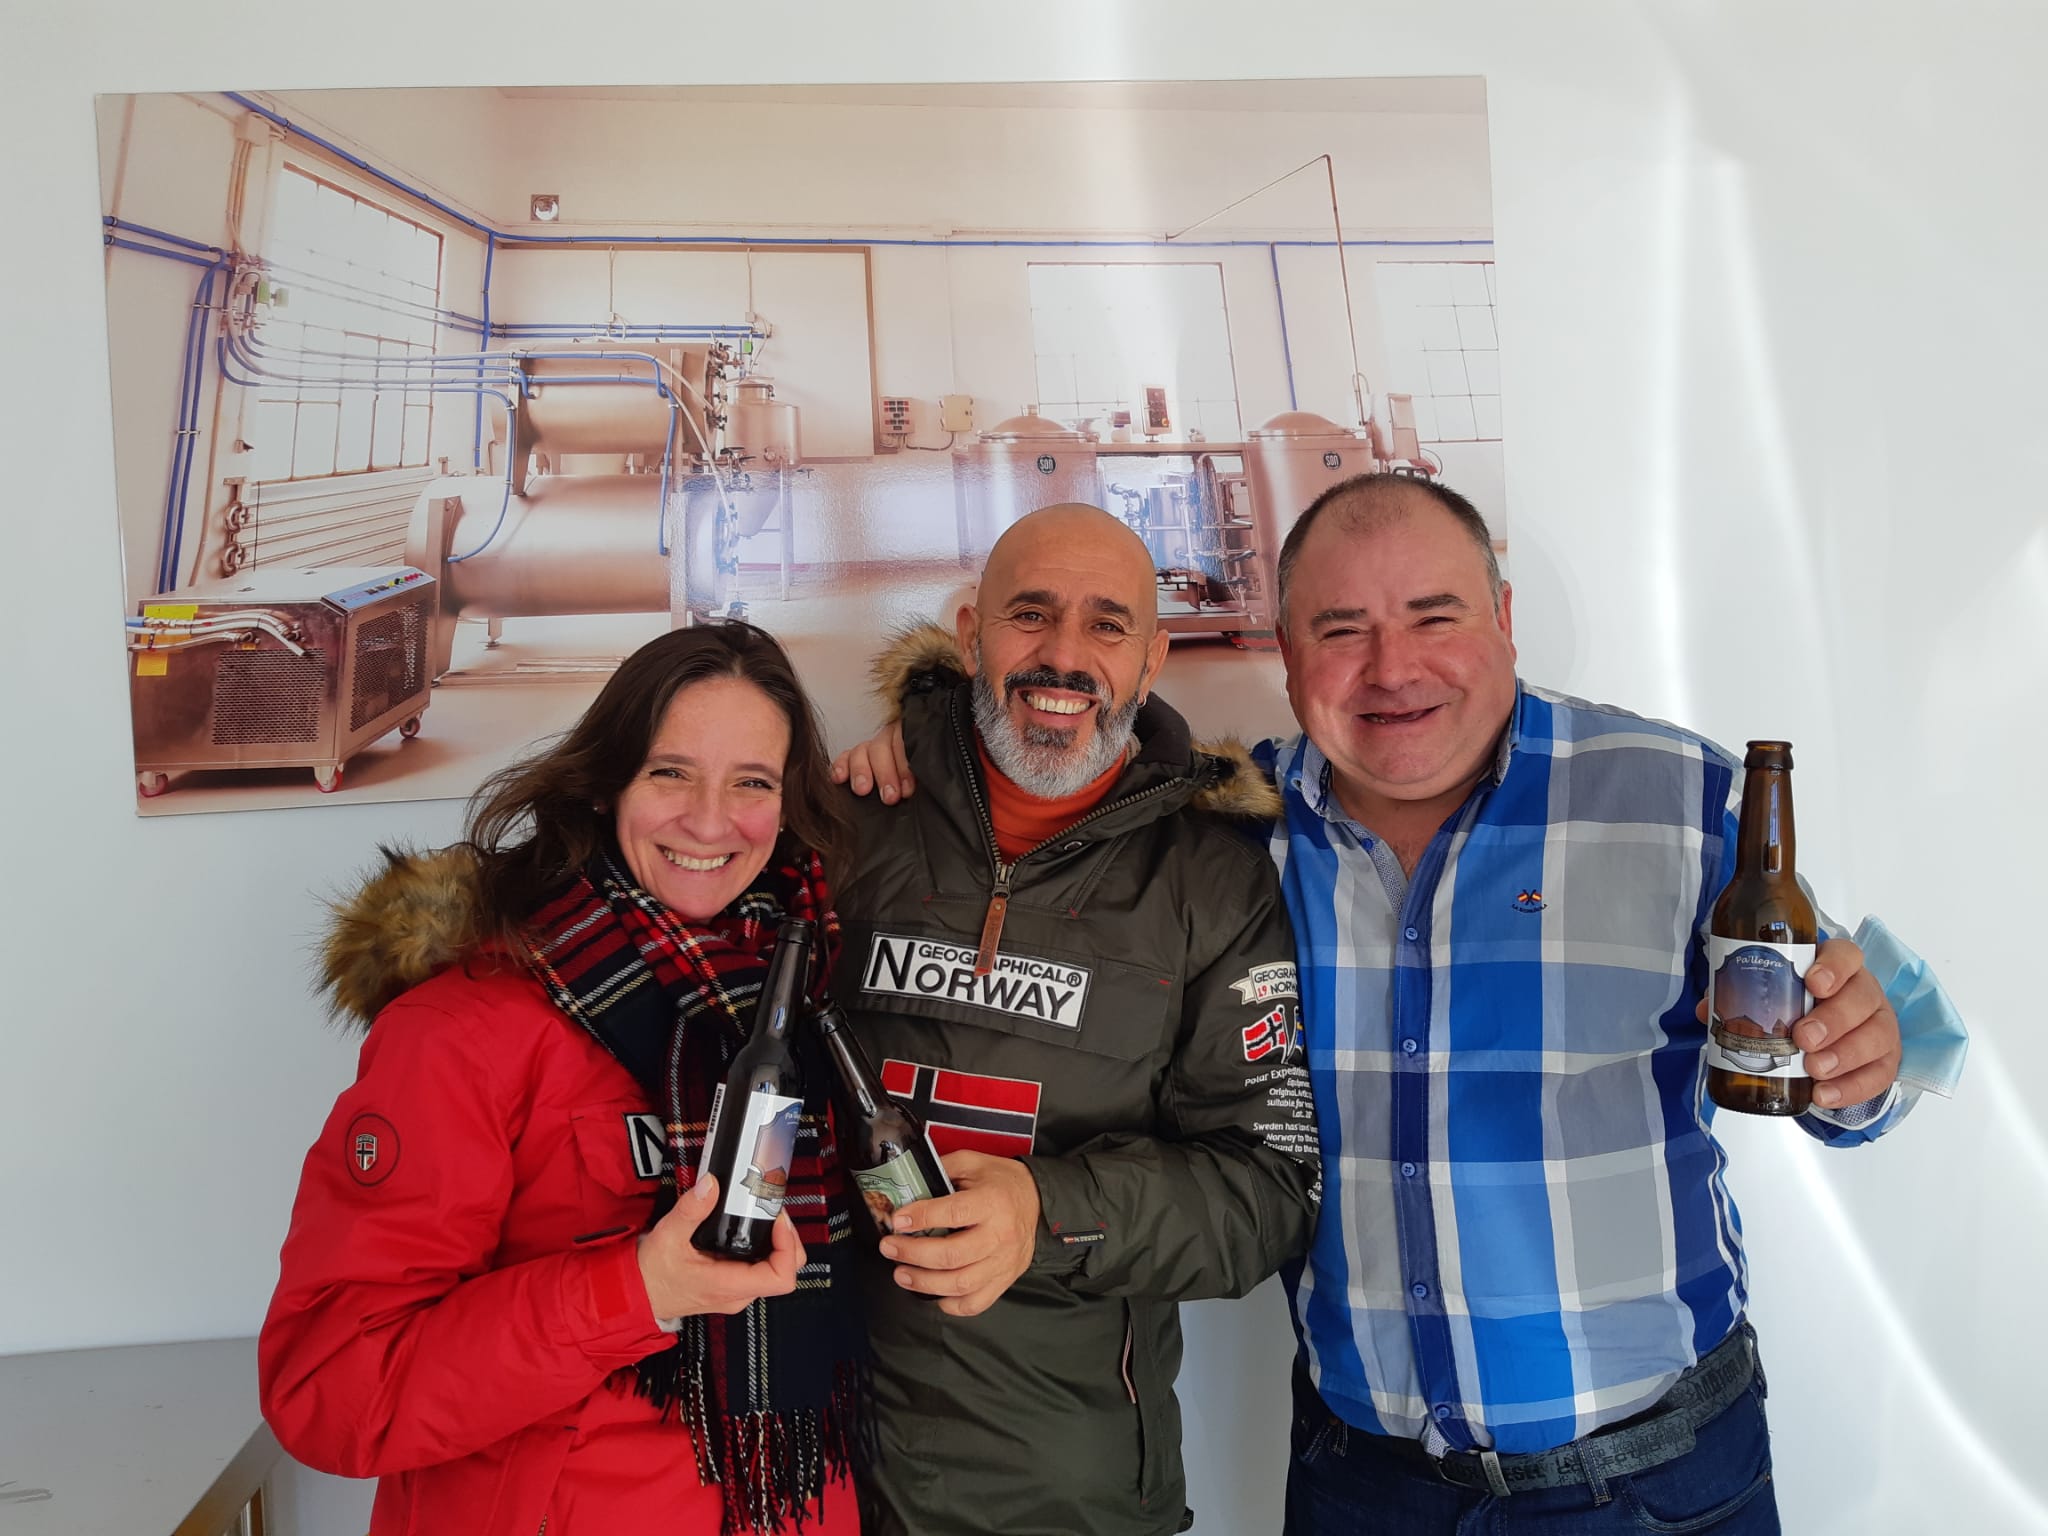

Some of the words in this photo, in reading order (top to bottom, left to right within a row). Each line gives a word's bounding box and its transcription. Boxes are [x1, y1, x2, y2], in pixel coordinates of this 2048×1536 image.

[919, 944, 1082, 987] GEOGPHICAL®
[1257, 985, 1268, 997] 19
[1244, 1073, 1269, 1087] Polar
[1253, 1122, 1284, 1131] Sweden
[1266, 1133, 1297, 1143] Norway
